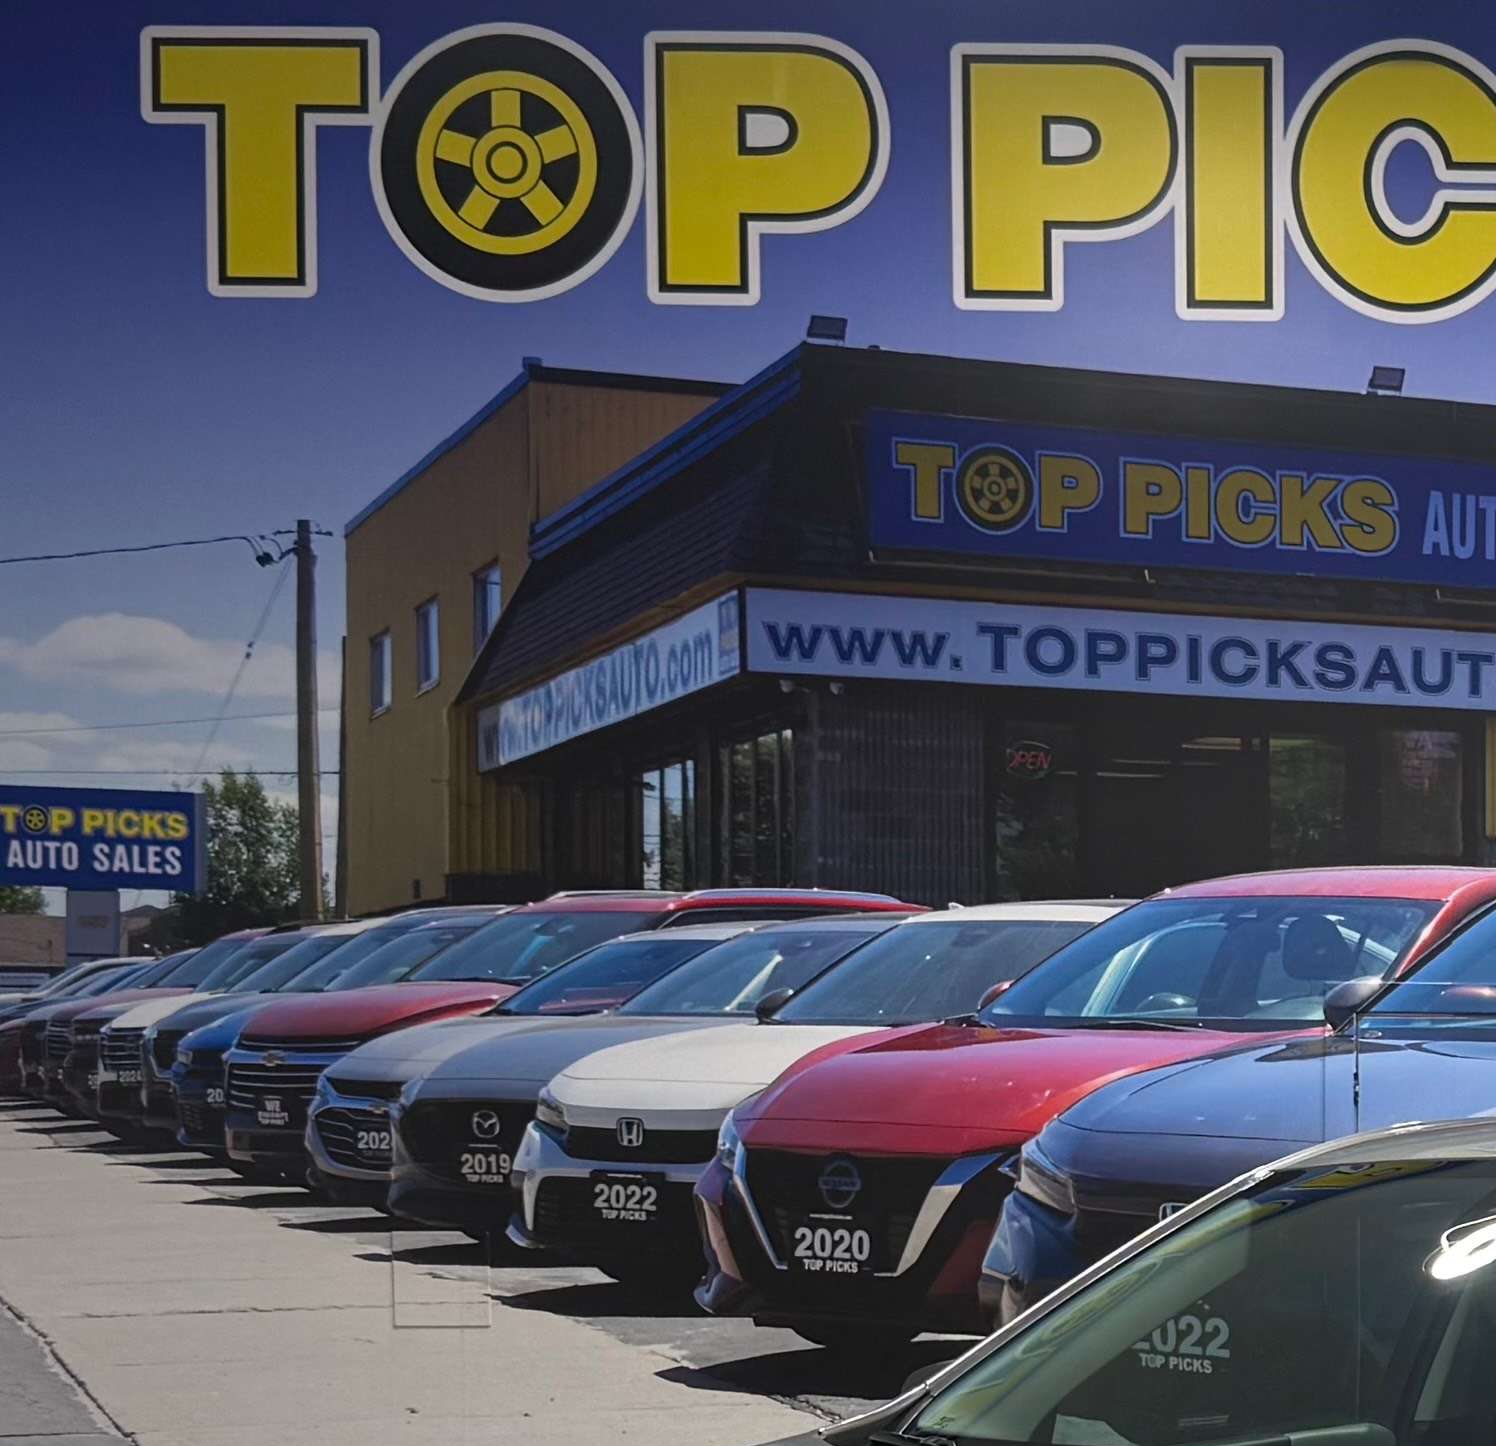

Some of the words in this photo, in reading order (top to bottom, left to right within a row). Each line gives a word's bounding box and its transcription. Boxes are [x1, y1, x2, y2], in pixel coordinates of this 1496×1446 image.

[141, 24, 890, 306] TOP
[891, 436, 1102, 535] TOP
[1119, 454, 1400, 557] PICKS
[0, 806, 76, 836] TOP
[82, 808, 189, 839] PICKS
[7, 840, 78, 870] AUTO
[93, 843, 182, 876] SALES
[357, 1131, 391, 1149] 202
[460, 1153, 511, 1174] 2019
[593, 1183, 657, 1211] 2022
[794, 1226, 870, 1261] 2020
[803, 1258, 823, 1271] TOP
[825, 1259, 859, 1274] PICKS
[1138, 1352, 1165, 1369] TOP
[1168, 1354, 1213, 1374] PICKS
